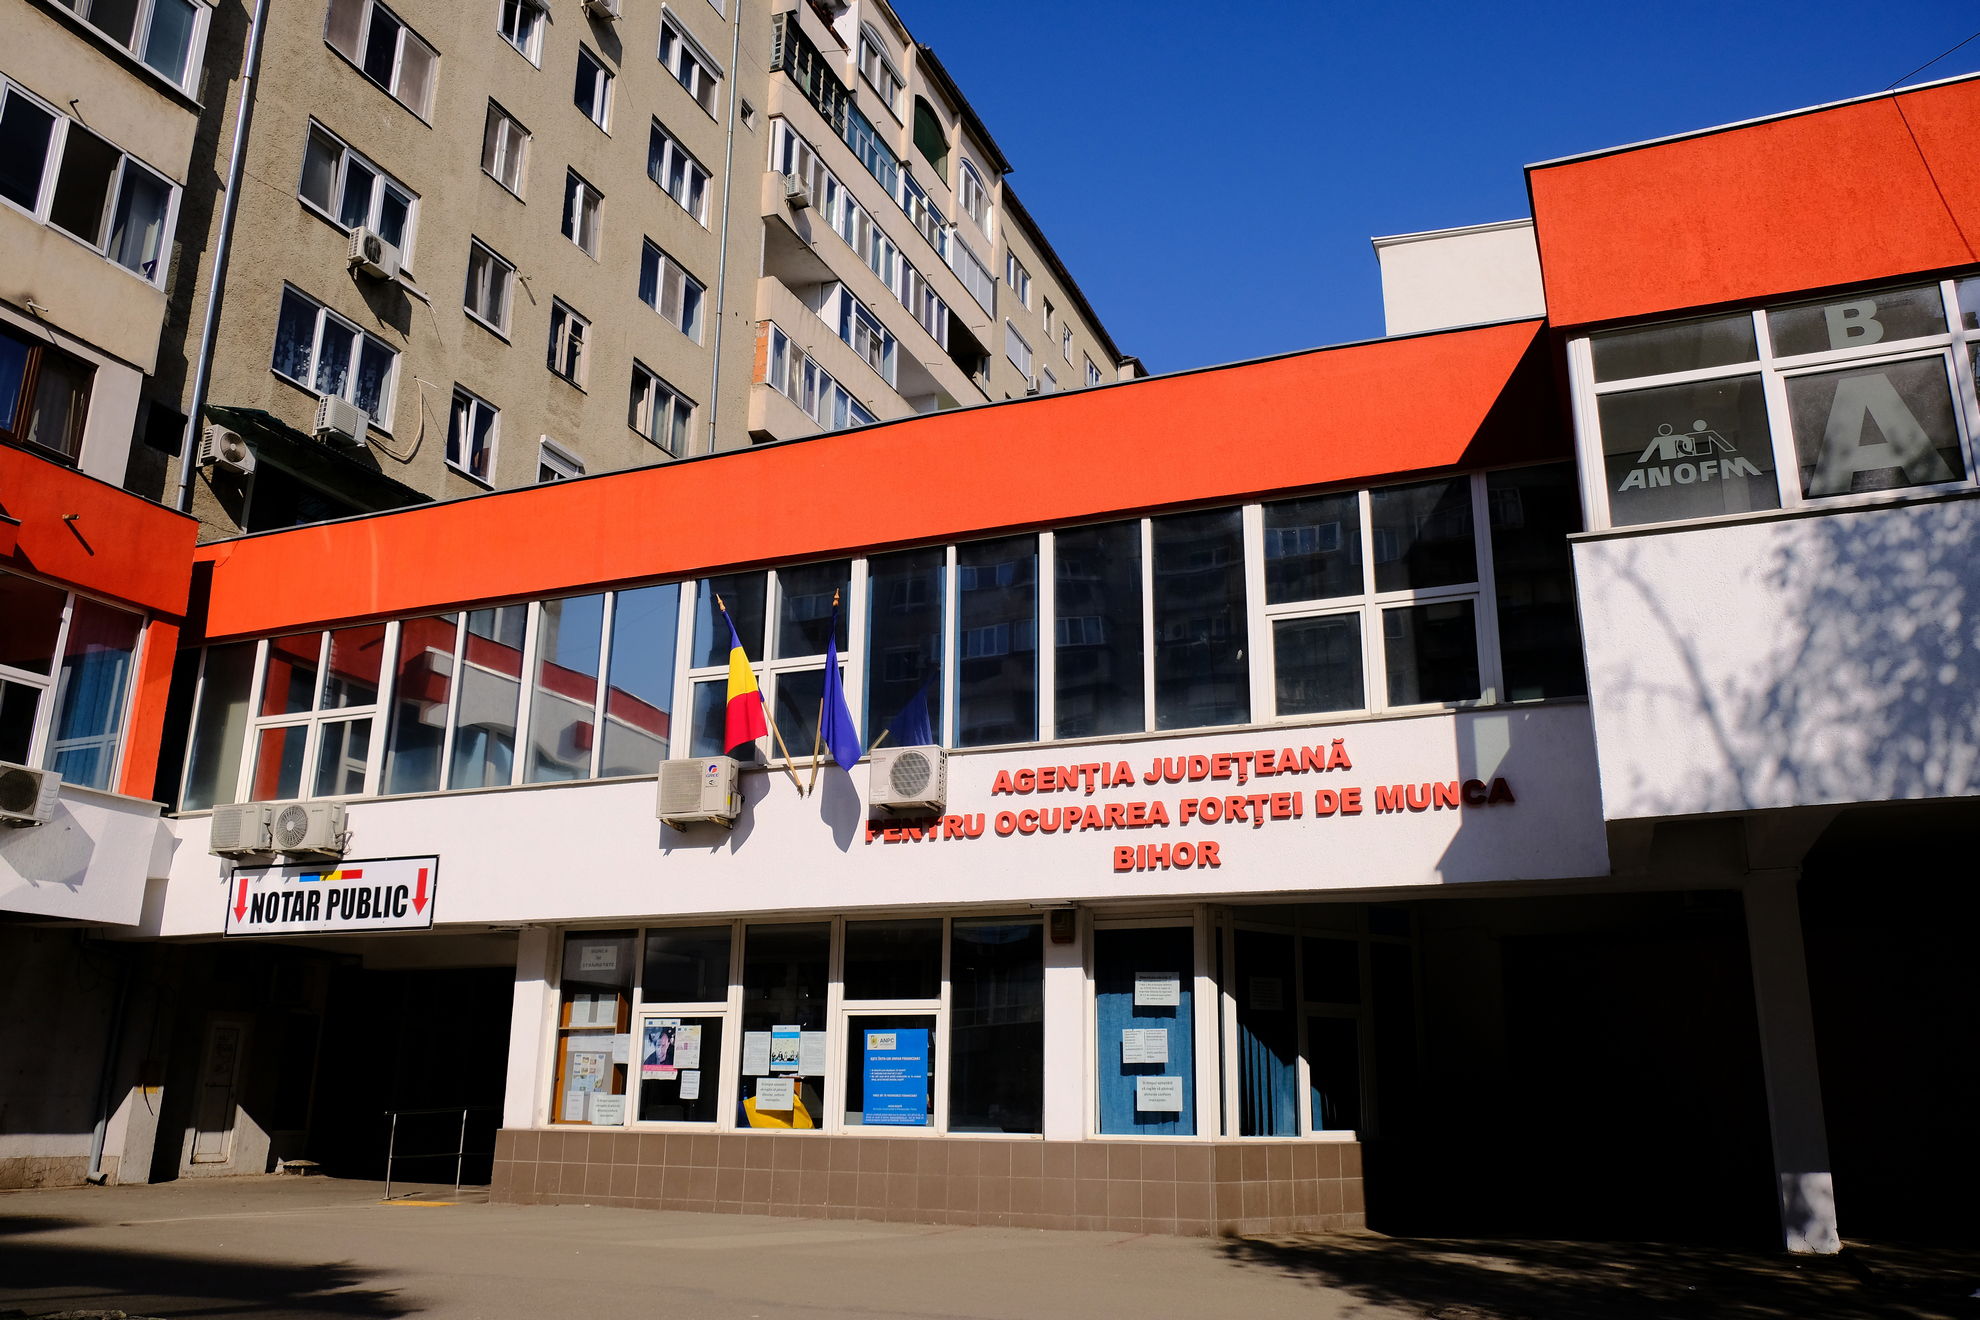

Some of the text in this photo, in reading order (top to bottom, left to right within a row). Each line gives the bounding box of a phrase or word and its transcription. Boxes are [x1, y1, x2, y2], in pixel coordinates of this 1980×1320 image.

[1824, 300, 1884, 350] B
[1808, 373, 1956, 497] A
[1617, 456, 1762, 492] ANOFM
[865, 813, 985, 842] PENTRU
[994, 801, 1170, 835] OCUPAREA
[1315, 787, 1363, 815] DE
[1375, 777, 1516, 811] MUNCA
[1113, 840, 1222, 873] BIHOR
[250, 885, 409, 924] NOTAR PUBLIC
